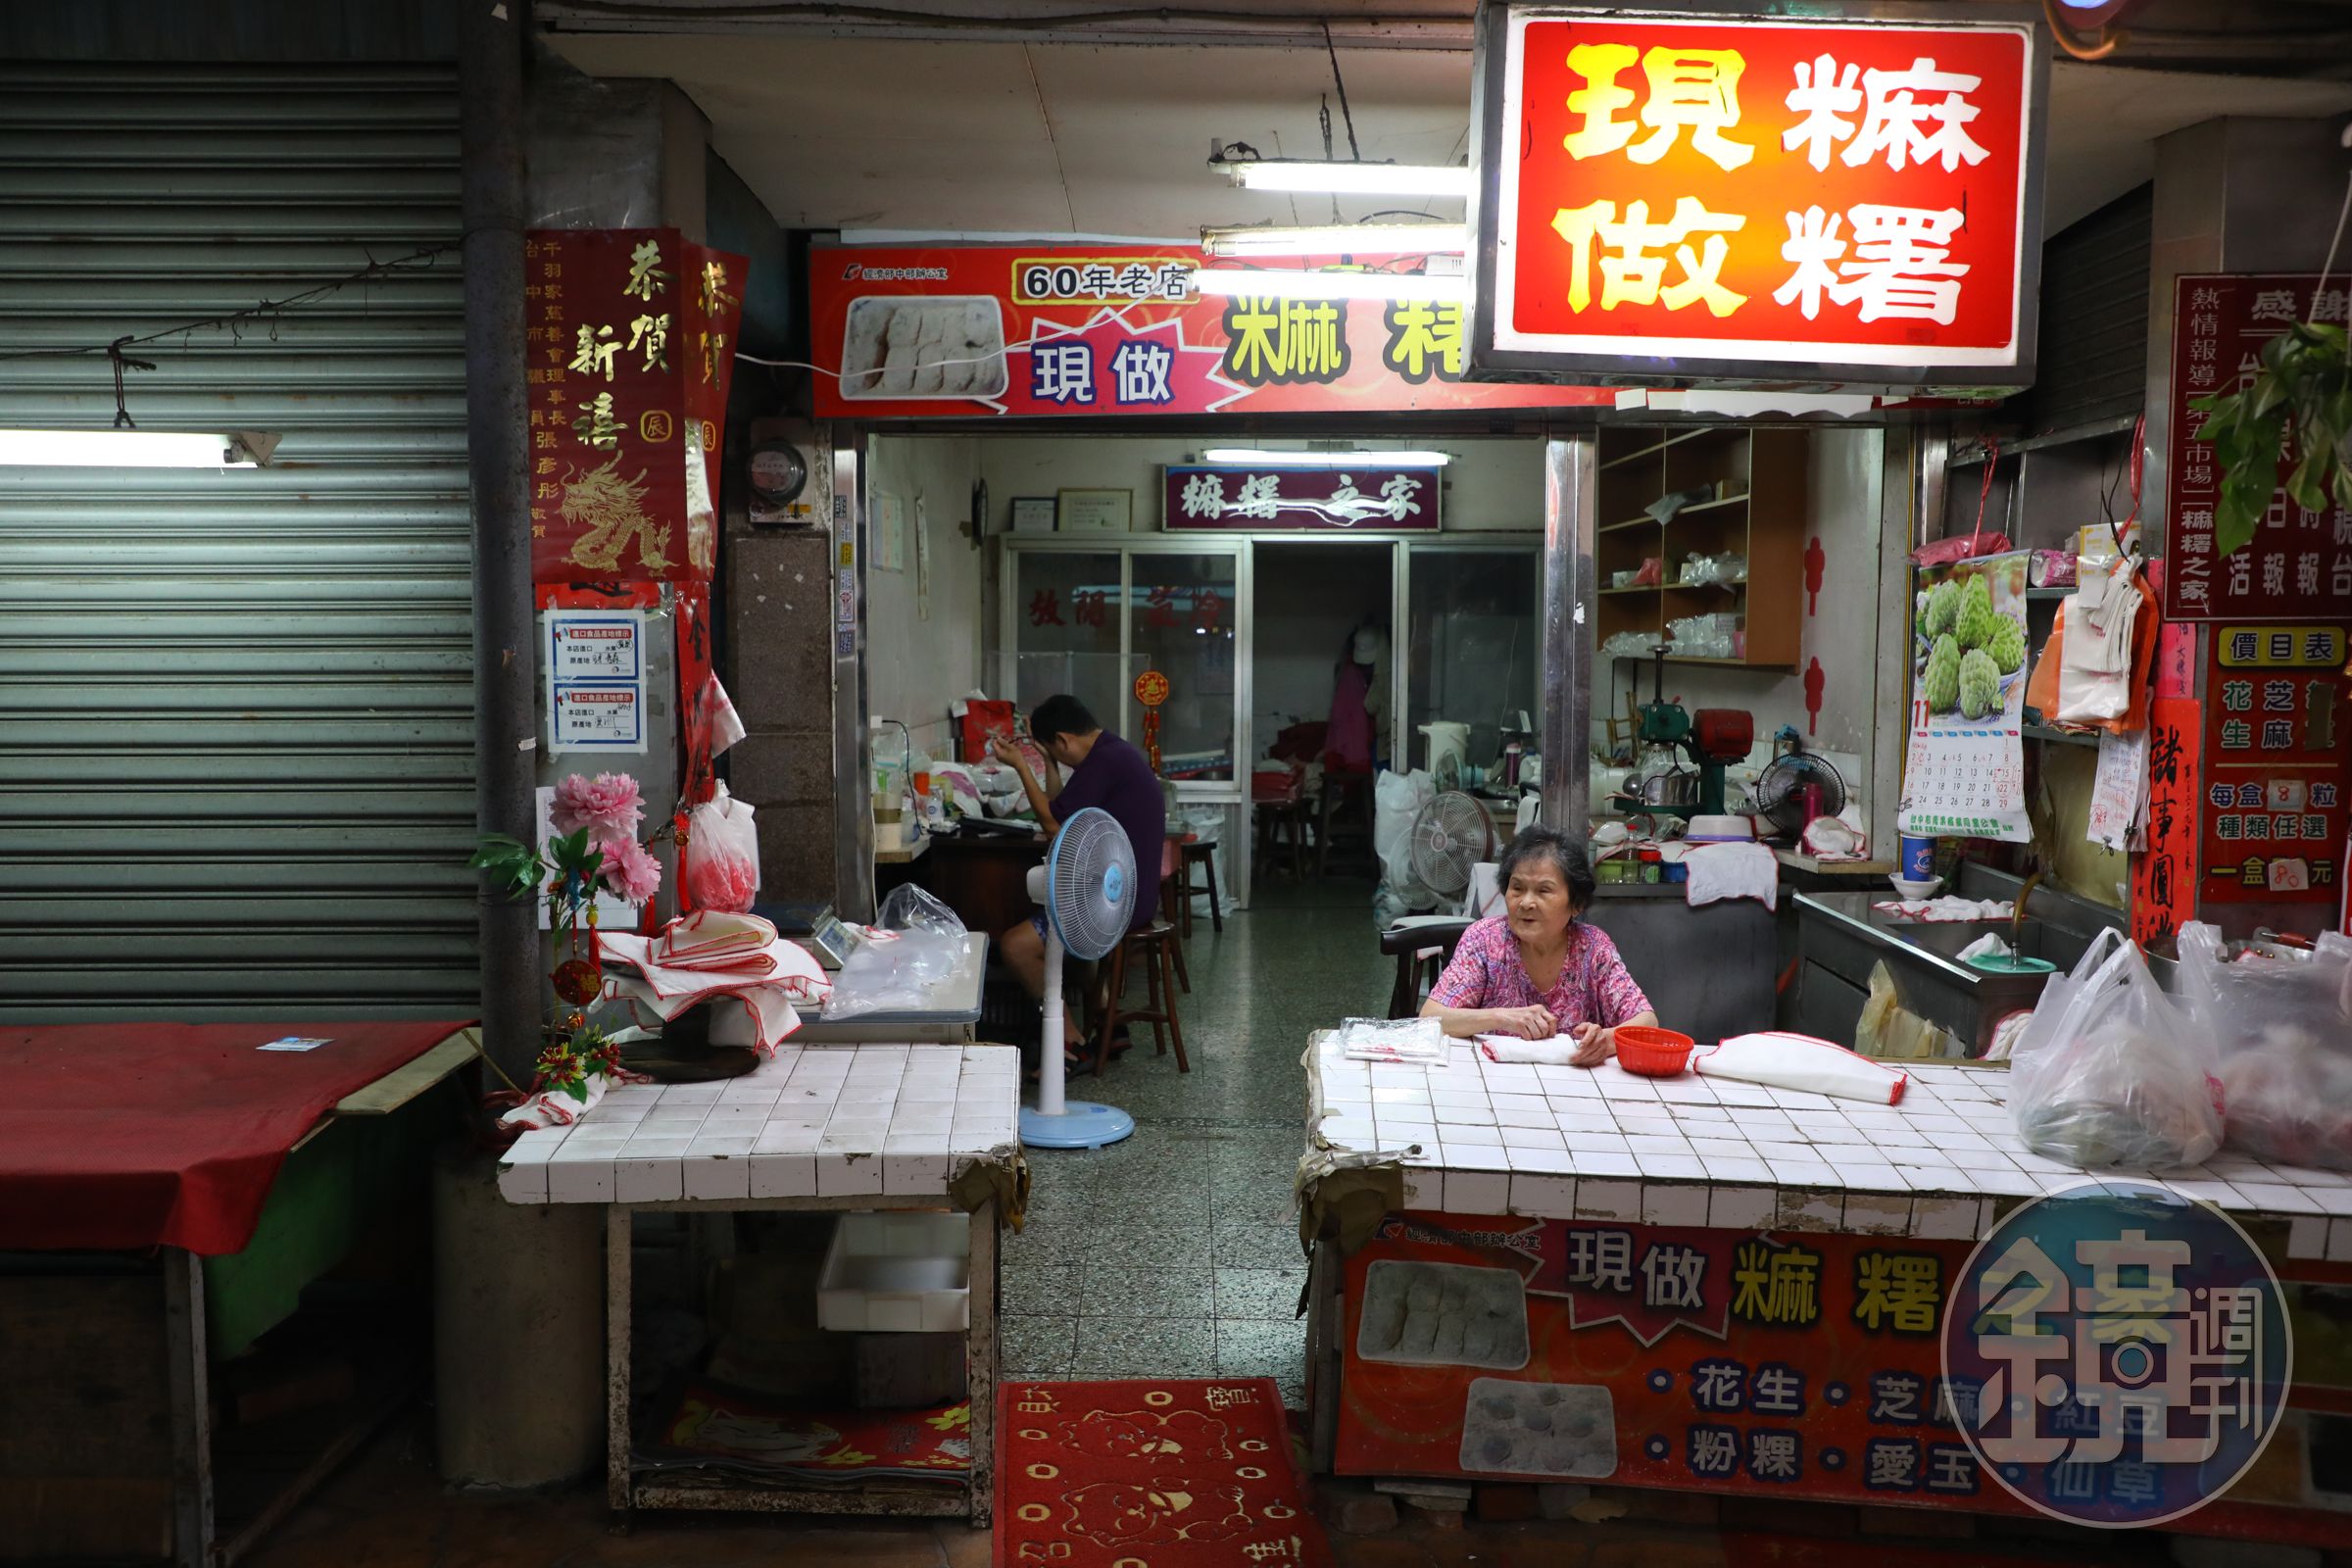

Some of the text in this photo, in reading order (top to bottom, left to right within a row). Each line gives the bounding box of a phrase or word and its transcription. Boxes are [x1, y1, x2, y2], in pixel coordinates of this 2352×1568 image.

[623, 239, 676, 374] 恭賀
[1024, 265, 1192, 300] 60年老店
[2186, 287, 2220, 386] 熱情報導
[567, 322, 628, 450] 新禧
[1034, 343, 1173, 403] 現做
[2230, 632, 2334, 661] 價目表
[1914, 701, 1931, 728] 11
[2221, 681, 2253, 749] 花生
[2262, 681, 2295, 749] 芝麻
[2217, 815, 2328, 840] 種類任選
[1569, 1230, 1706, 1309] 現做
[1697, 1365, 1800, 1412] 花生
[1693, 1429, 1797, 1477] 粉粿
[1870, 1444, 1974, 1491] 愛玉
